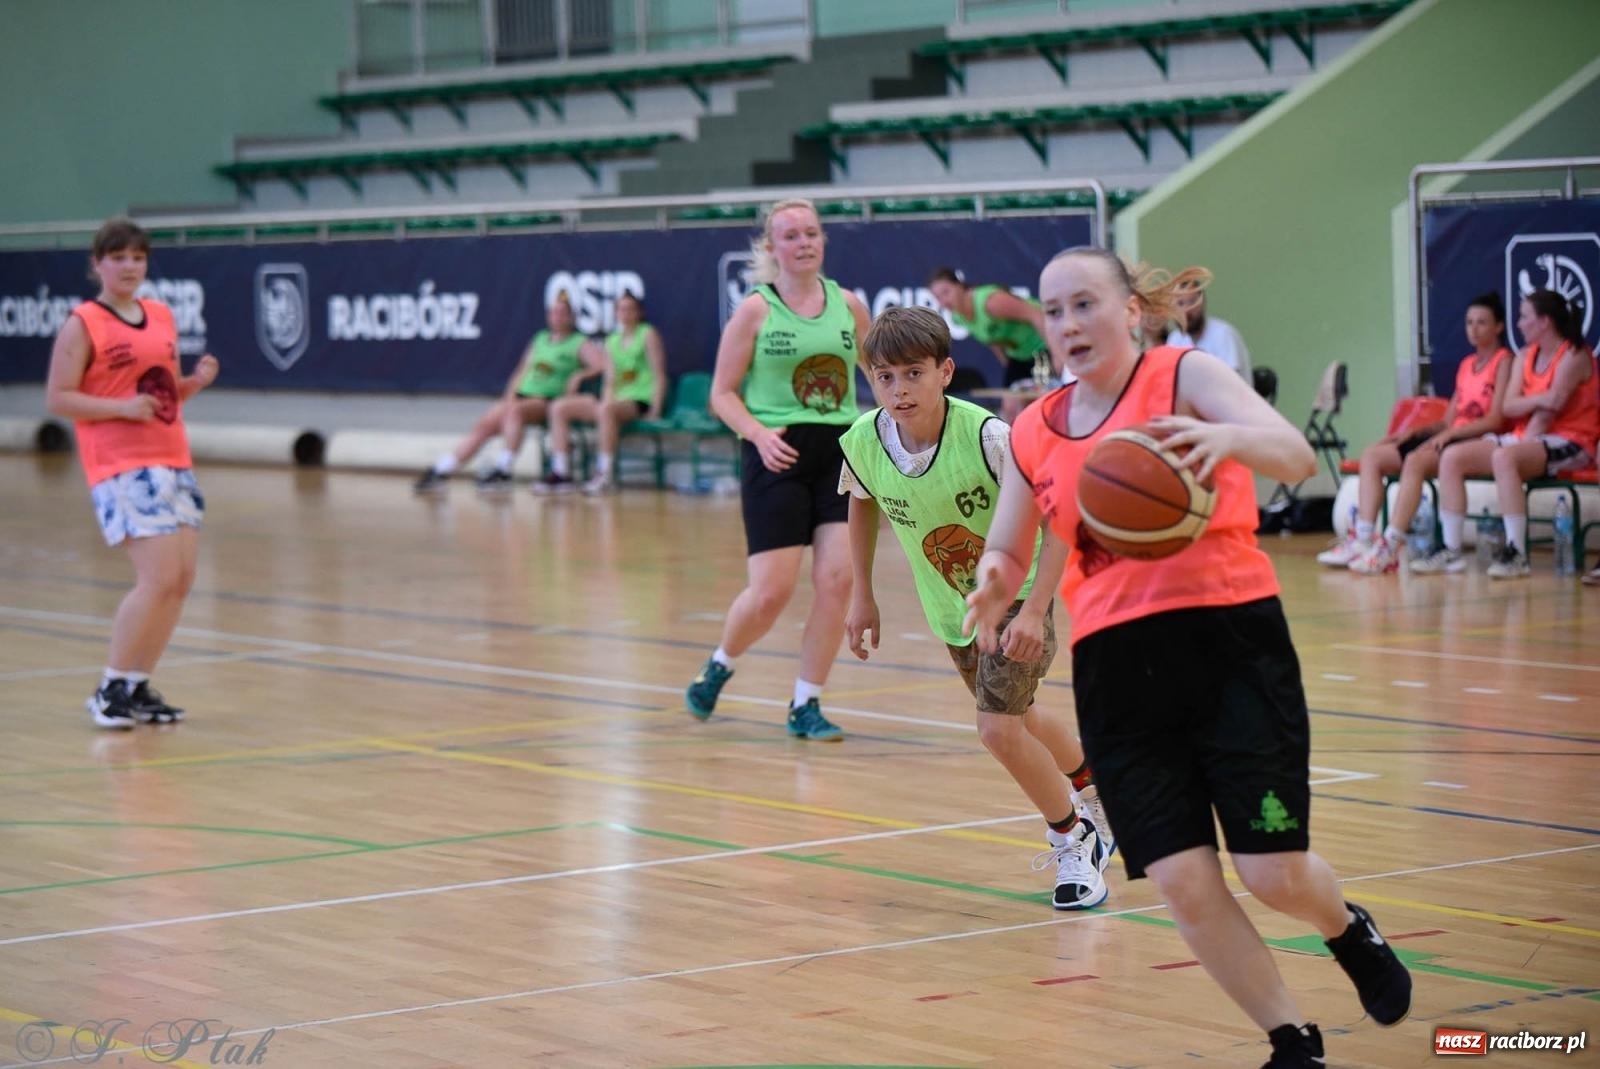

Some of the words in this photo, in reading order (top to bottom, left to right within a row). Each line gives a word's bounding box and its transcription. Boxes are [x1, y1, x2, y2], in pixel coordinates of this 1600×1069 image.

[0, 284, 83, 337] CIBÓR
[328, 279, 481, 341] RACIBÓRZ
[886, 506, 908, 519] LIGA
[955, 486, 990, 518] 63
